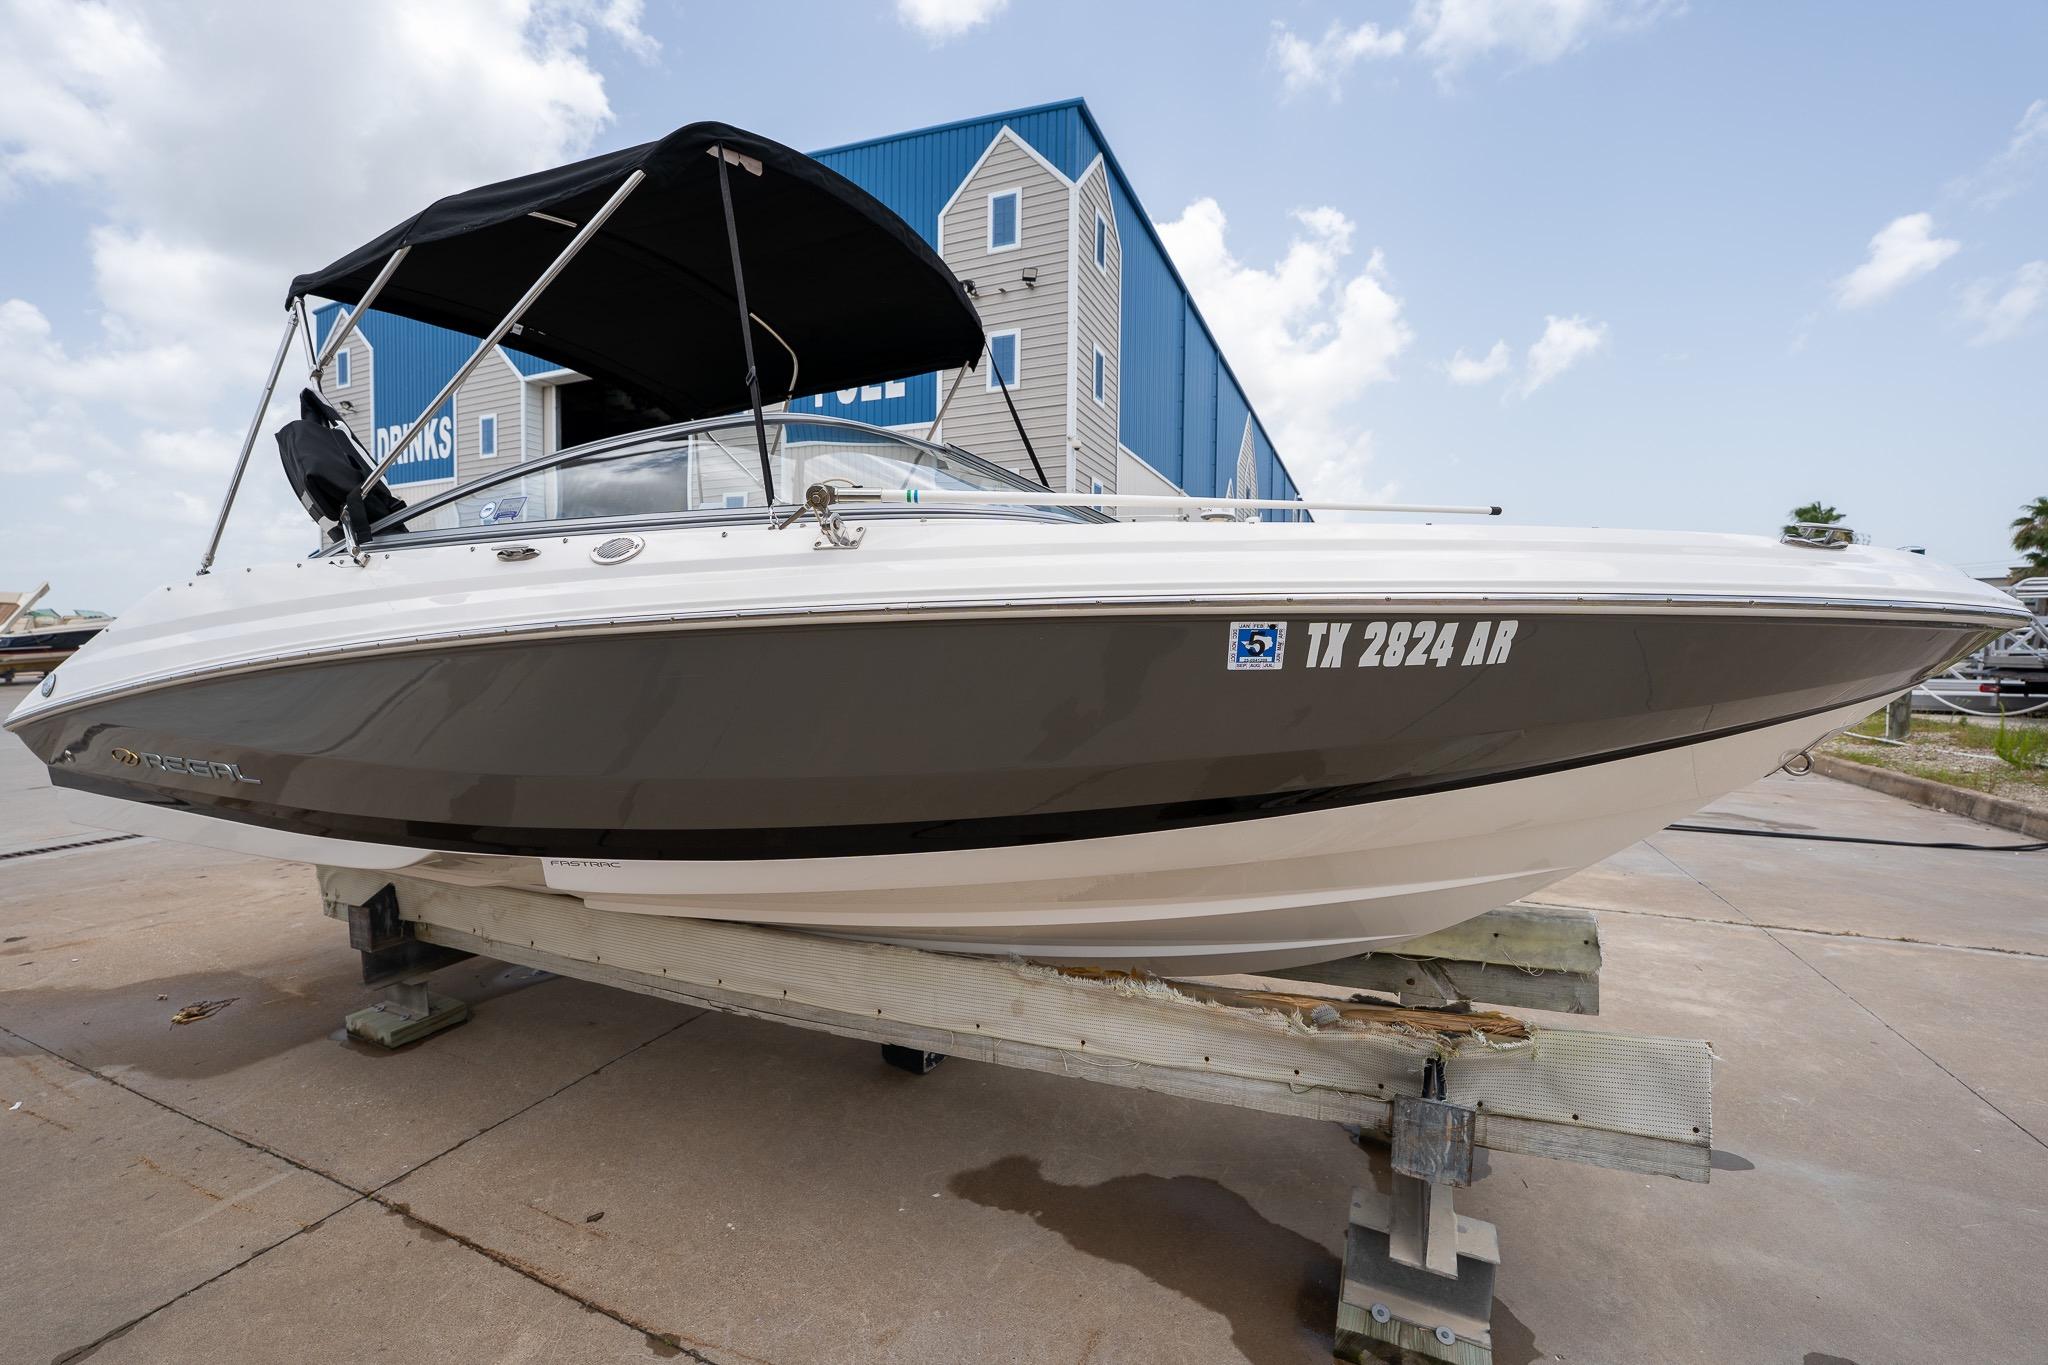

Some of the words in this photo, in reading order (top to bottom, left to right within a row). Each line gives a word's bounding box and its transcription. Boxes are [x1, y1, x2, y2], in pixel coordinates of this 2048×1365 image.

[377, 415, 452, 465] DRINKS
[1247, 630, 1266, 657] 5
[1306, 622, 1352, 668] TX
[1358, 620, 1459, 668] 2824
[1461, 620, 1519, 667] AR
[140, 751, 264, 786] REGAL
[550, 860, 622, 868] FASTRAC
